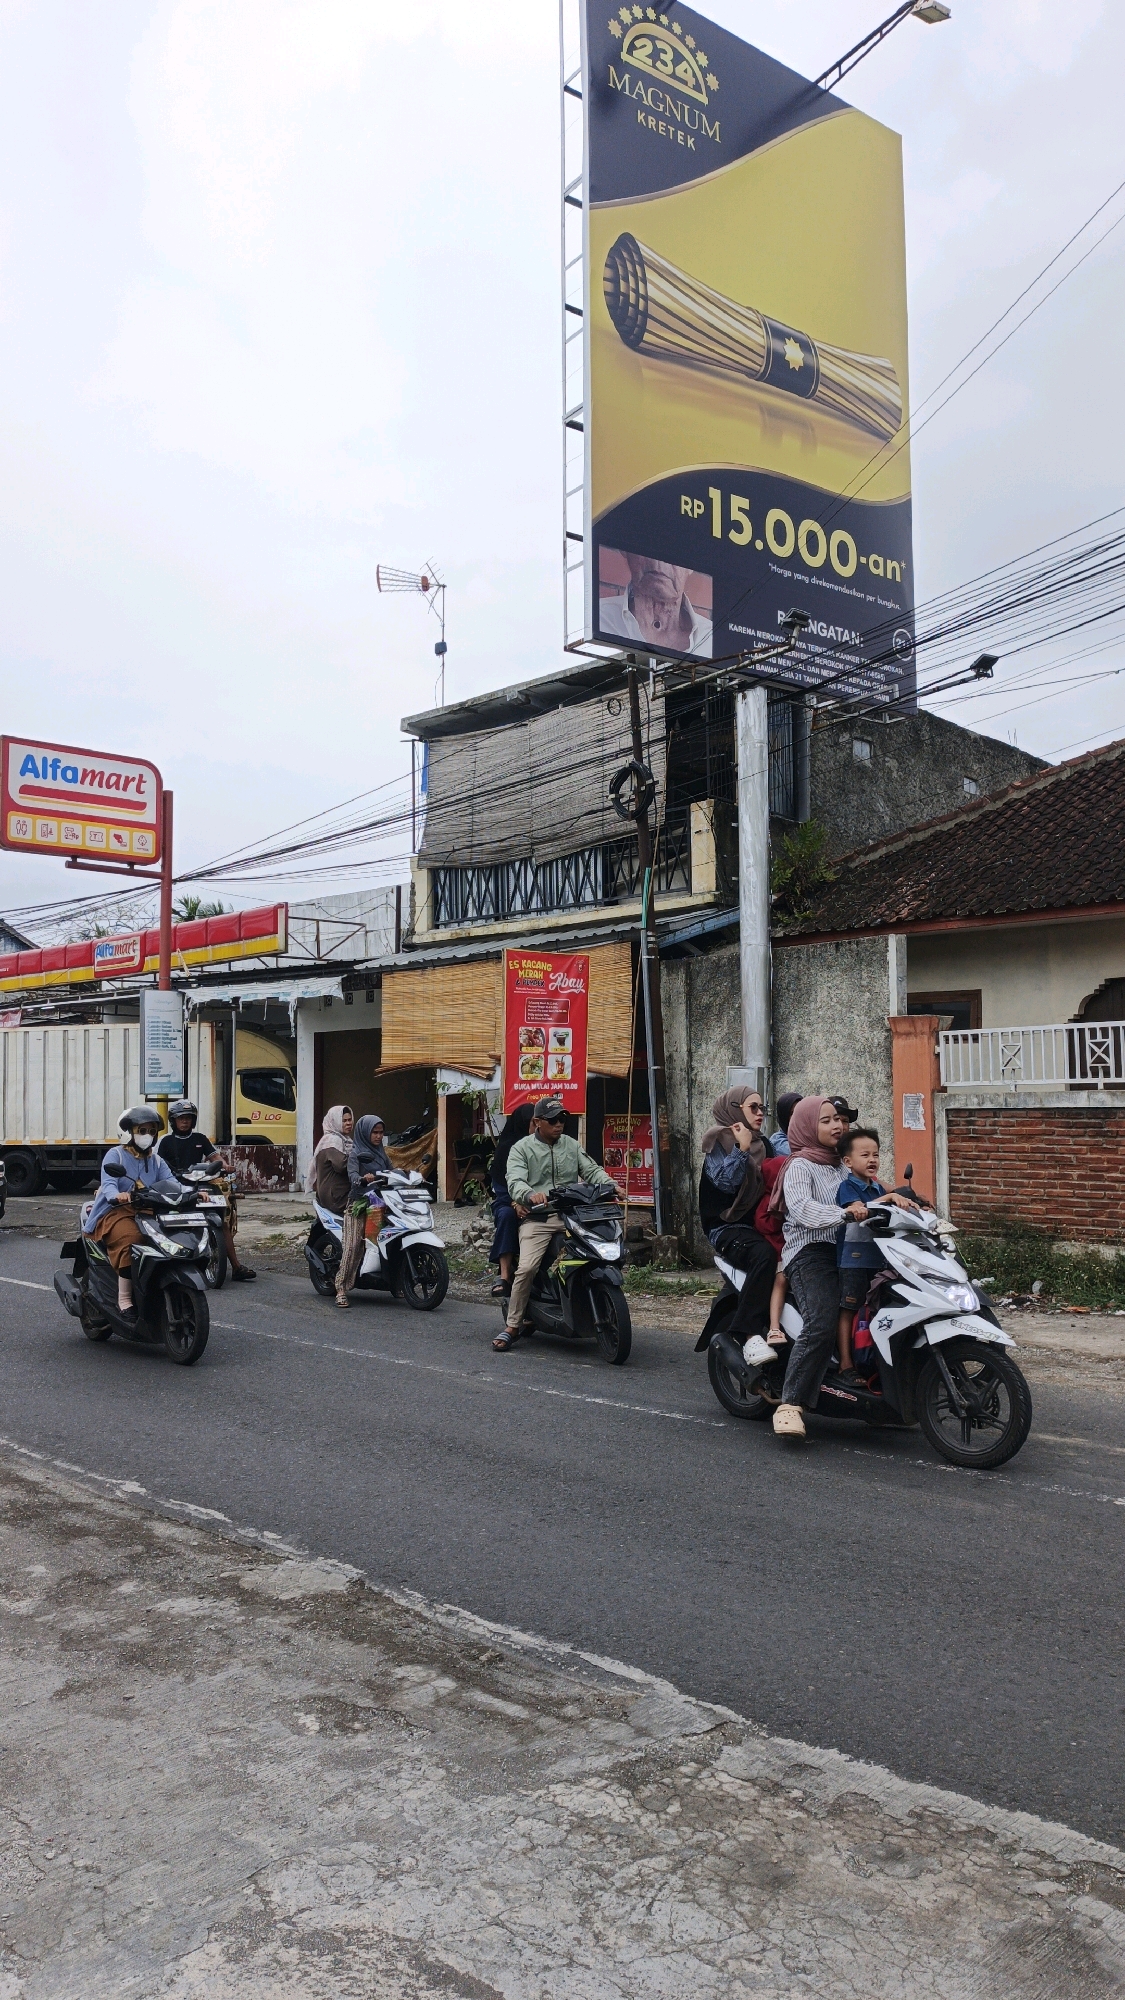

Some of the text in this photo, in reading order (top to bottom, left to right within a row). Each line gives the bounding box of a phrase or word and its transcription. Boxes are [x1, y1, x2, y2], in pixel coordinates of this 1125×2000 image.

[632, 37, 697, 90] 234
[607, 64, 722, 144] MAGNUM
[636, 109, 696, 151] KRETEK
[680, 494, 705, 520] RP
[793, 571, 810, 584] yang
[866, 593, 876, 603] per
[728, 623, 757, 637] KARENA
[795, 672, 802, 681] 21
[807, 664, 821, 675] DAN
[848, 675, 872, 688] KEPADA
[19, 753, 147, 796] Alfamart
[95, 937, 138, 960] Alfamart
[508, 959, 553, 972] ES KACANG
[518, 969, 544, 979] MERAH
[548, 972, 586, 994] Abay
[264, 1113, 282, 1121] LOG
